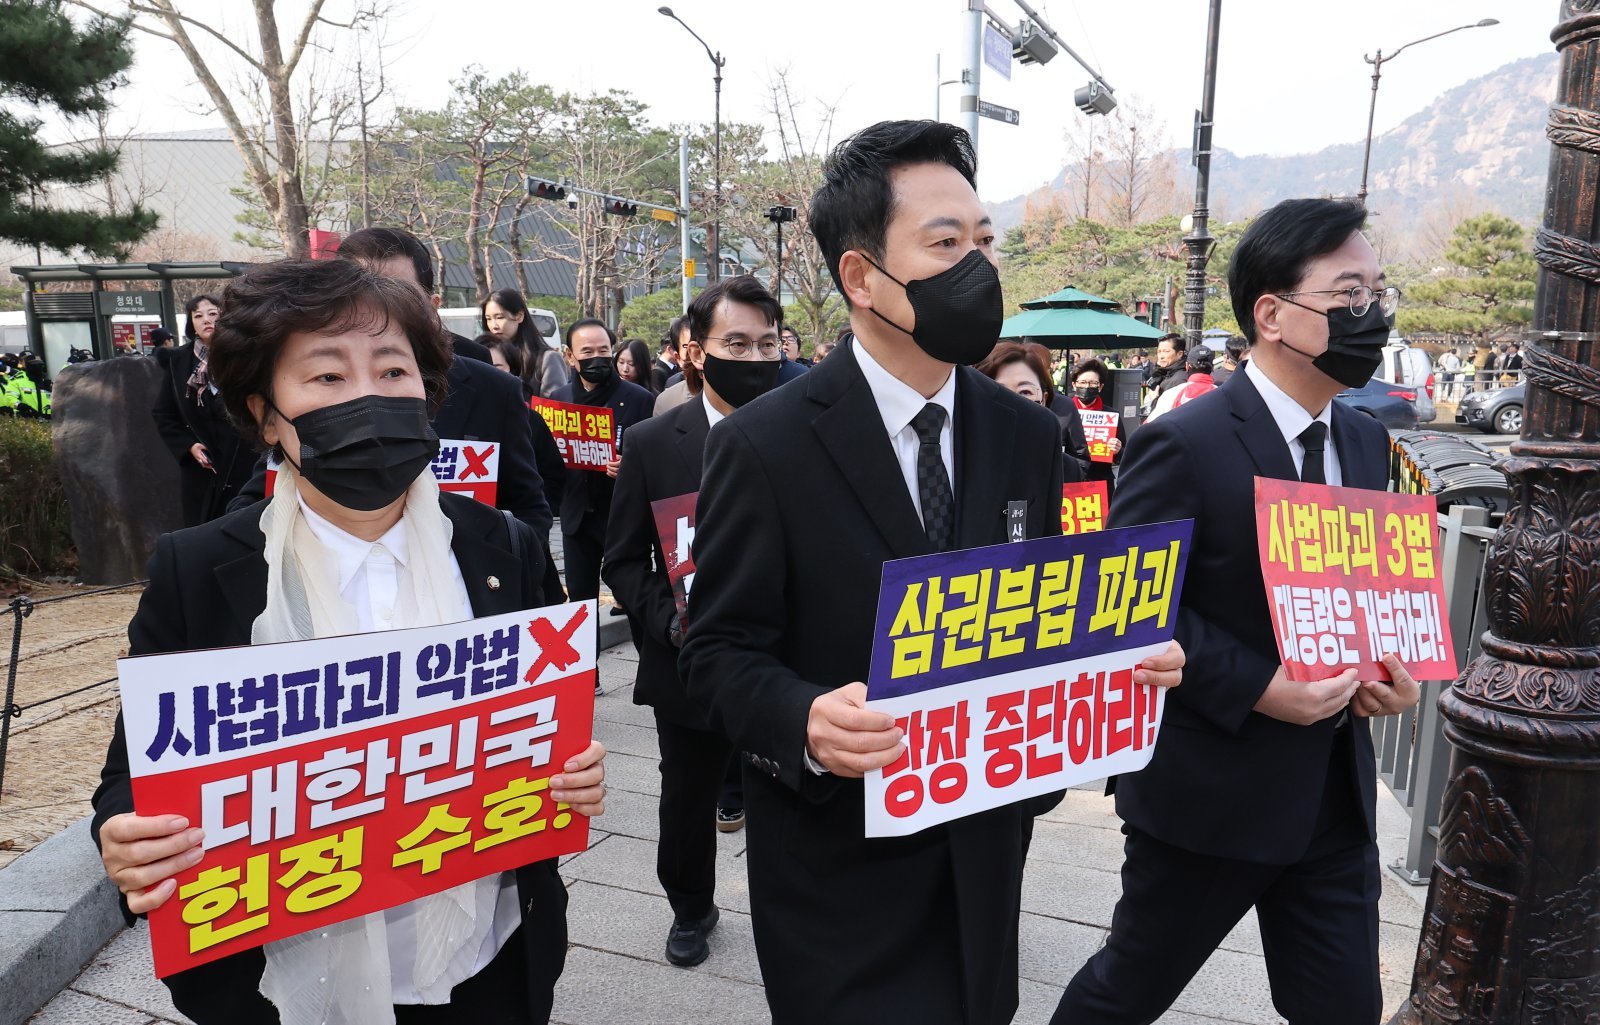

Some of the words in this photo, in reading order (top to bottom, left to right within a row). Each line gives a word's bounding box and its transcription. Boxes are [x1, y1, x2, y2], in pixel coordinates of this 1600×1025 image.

[117, 296, 142, 306] 청와대
[535, 405, 582, 436] 법파괴
[586, 414, 611, 439] 3법
[1086, 414, 1104, 424] 악법
[1061, 494, 1102, 535] 3법
[1268, 499, 1379, 577] 사법파괴
[1385, 512, 1435, 579] 3법
[888, 553, 1085, 679] 삼권분립
[1088, 540, 1181, 637] 파괴
[1273, 584, 1360, 666] 대통령은
[1356, 588, 1447, 663] 거부하라!
[145, 651, 402, 762] 사법파괴
[416, 624, 520, 701] 악법
[200, 695, 558, 851] 대한민국
[882, 700, 971, 818] 당장
[983, 664, 1158, 788] 중단하라!
[179, 826, 364, 954] 헌정
